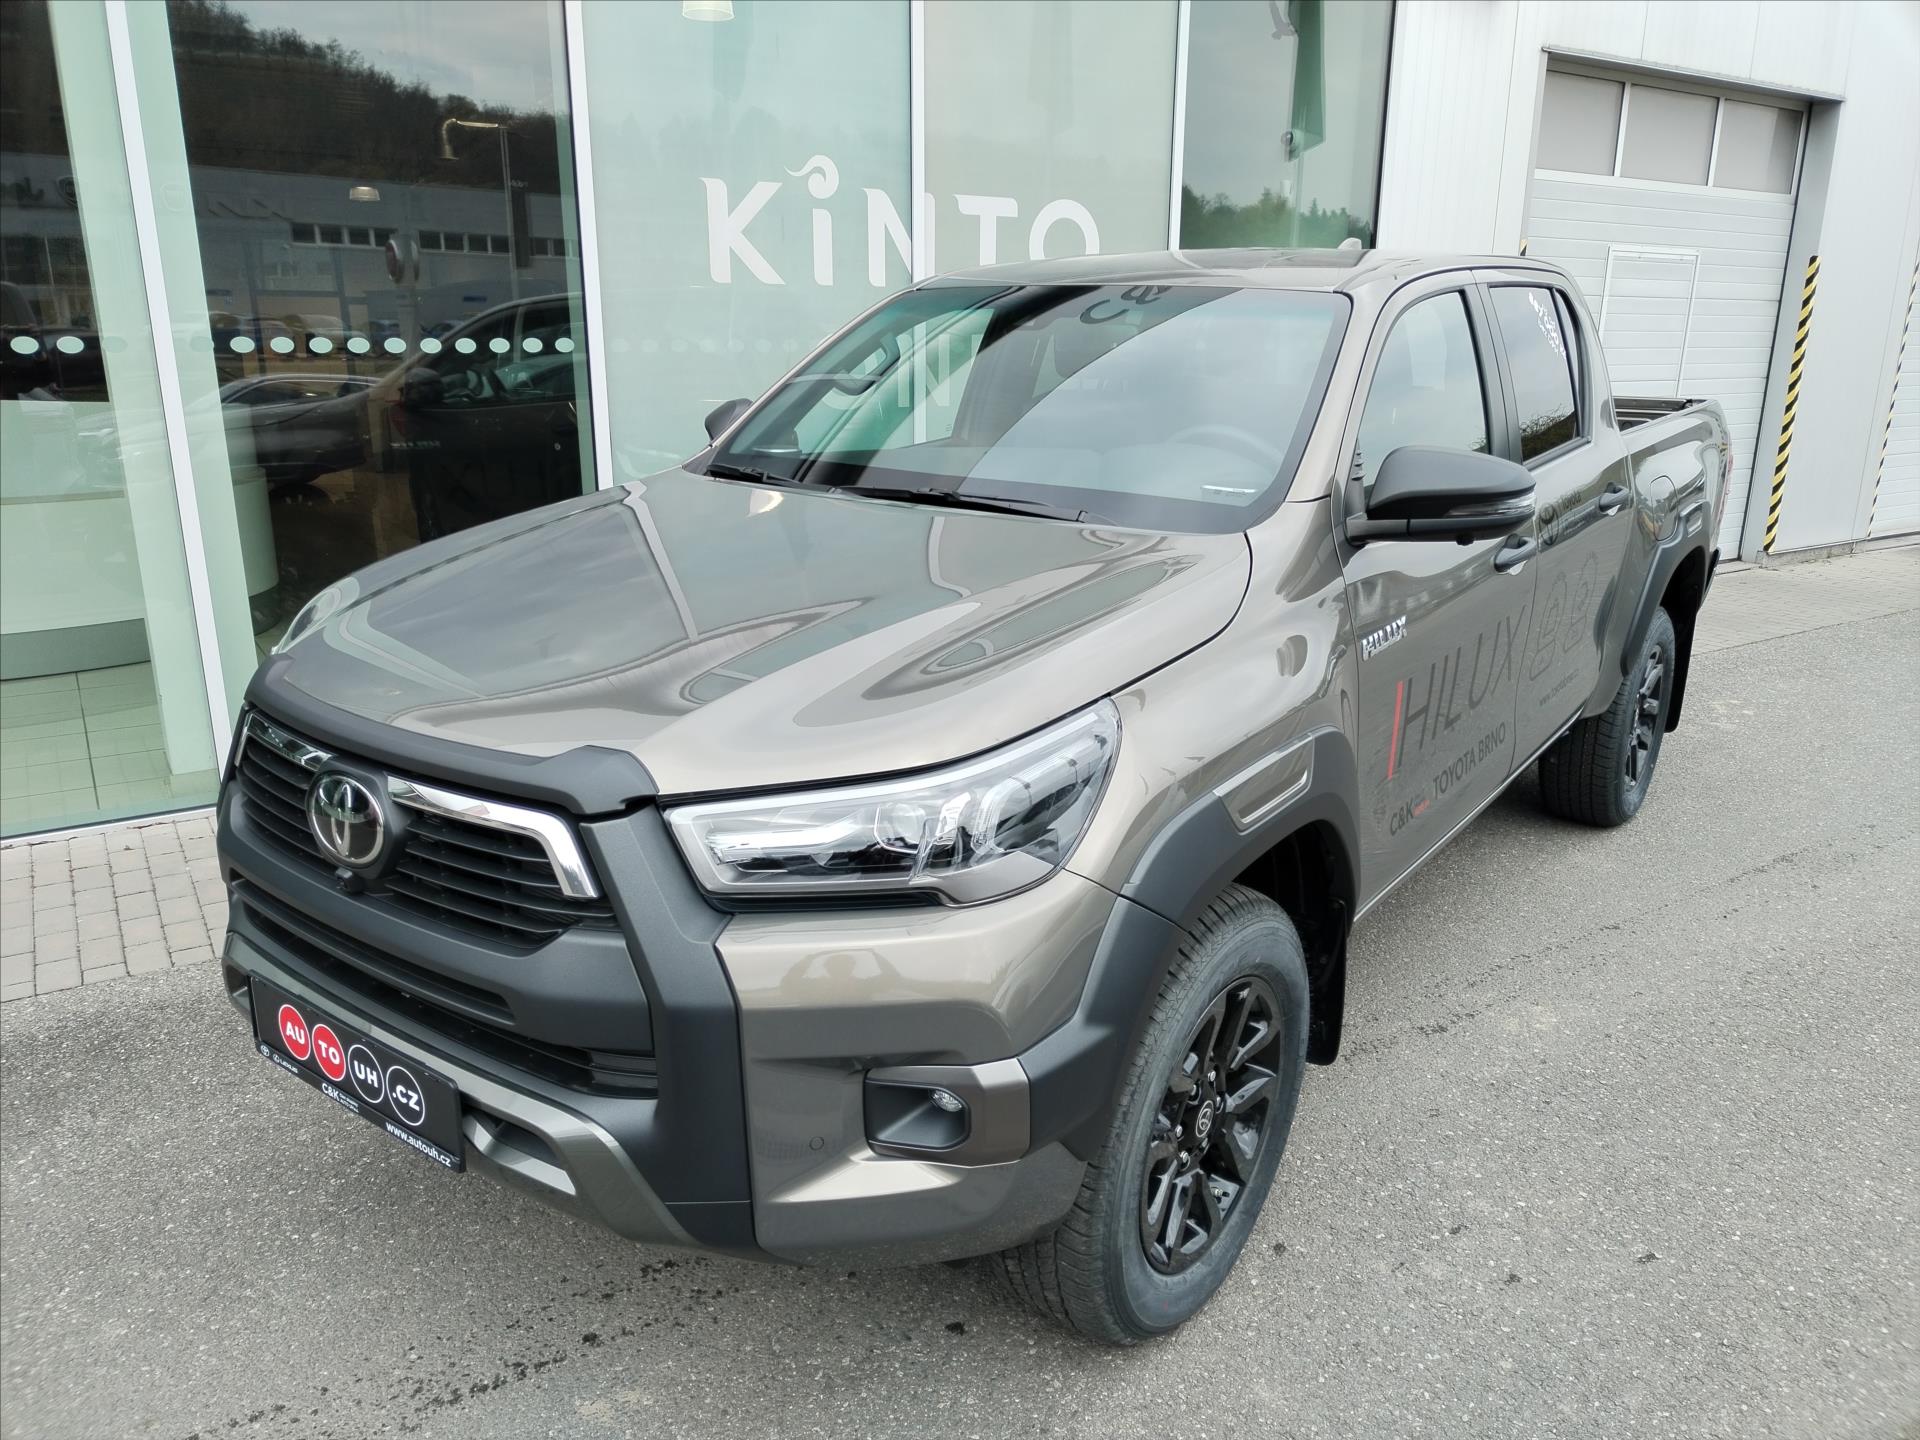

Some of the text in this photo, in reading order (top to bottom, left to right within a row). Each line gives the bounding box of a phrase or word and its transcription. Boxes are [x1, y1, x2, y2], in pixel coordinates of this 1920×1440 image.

[1361, 615, 1407, 661] HILUX
[1397, 605, 1527, 768] HILUX
[1390, 797, 1414, 836] C&K
[1432, 748, 1477, 799] TOYOTA
[1478, 721, 1507, 766] BRNO
[322, 1082, 340, 1102] C&K
[354, 1060, 379, 1088] UH
[386, 1122, 452, 1168] www.autouh.cz
